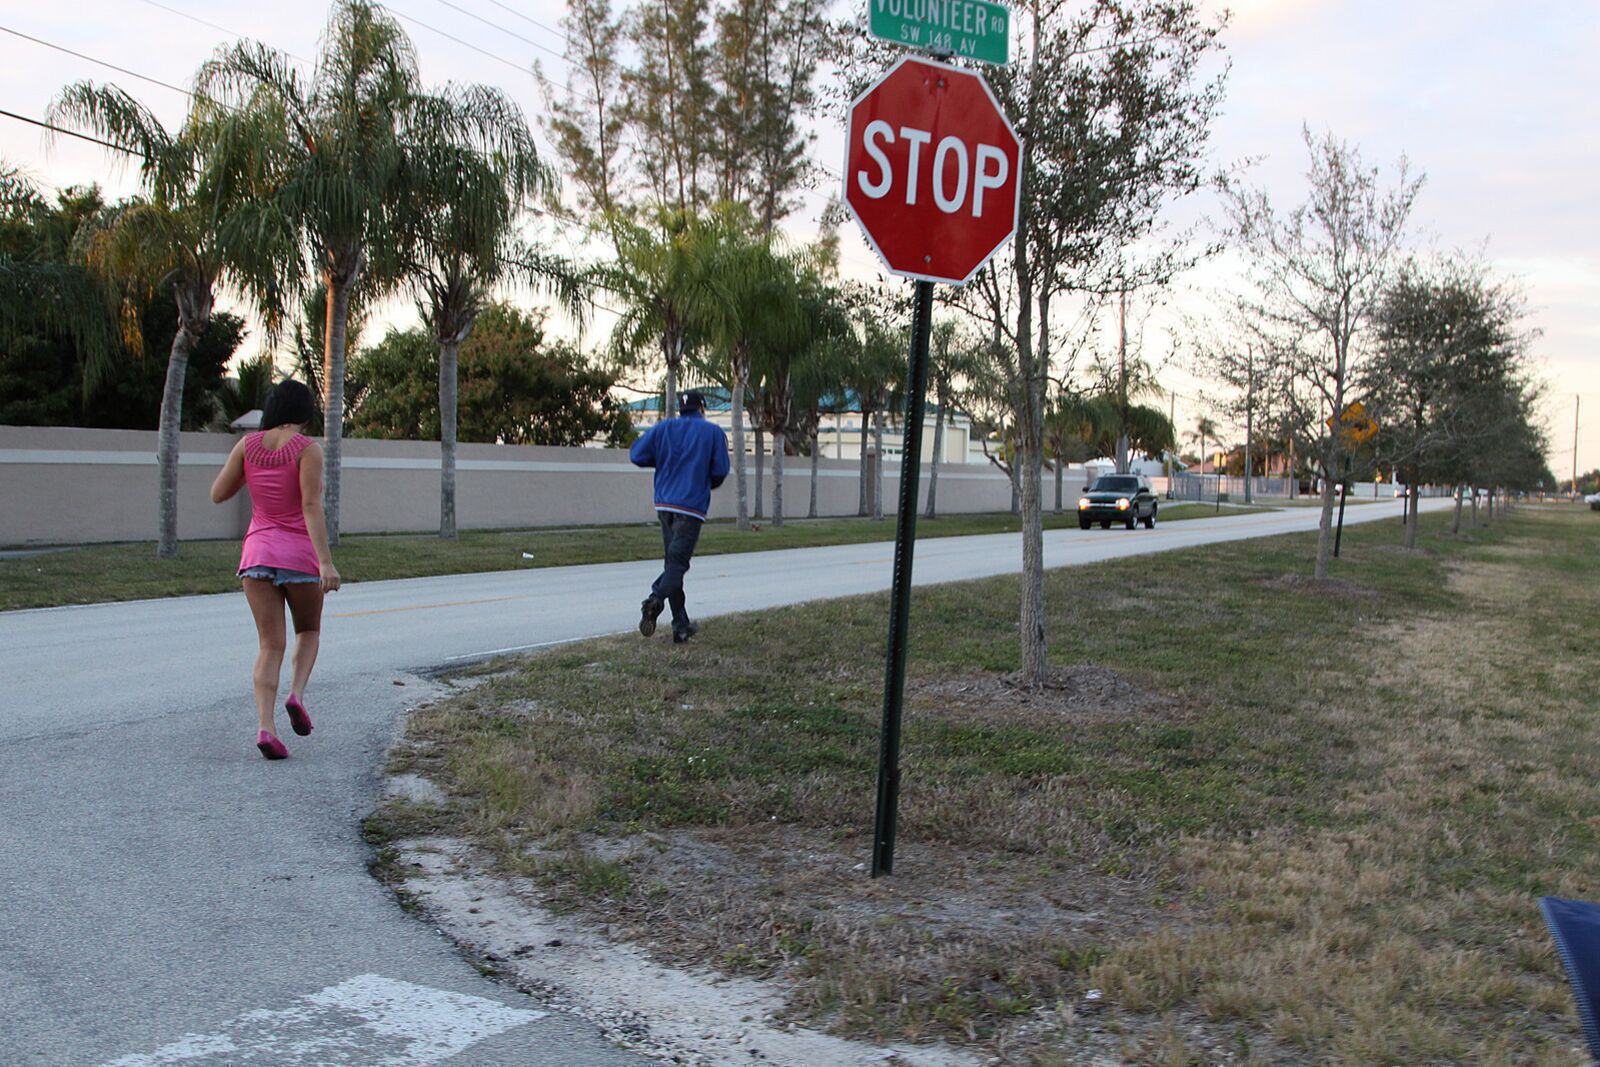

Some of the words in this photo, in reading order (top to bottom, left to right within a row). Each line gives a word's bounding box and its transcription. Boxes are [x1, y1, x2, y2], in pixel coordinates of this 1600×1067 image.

[900, 23, 920, 43] SW
[929, 29, 952, 49] 148
[959, 37, 976, 55] AV
[991, 15, 1004, 34] RD
[857, 119, 1009, 218] STOP
